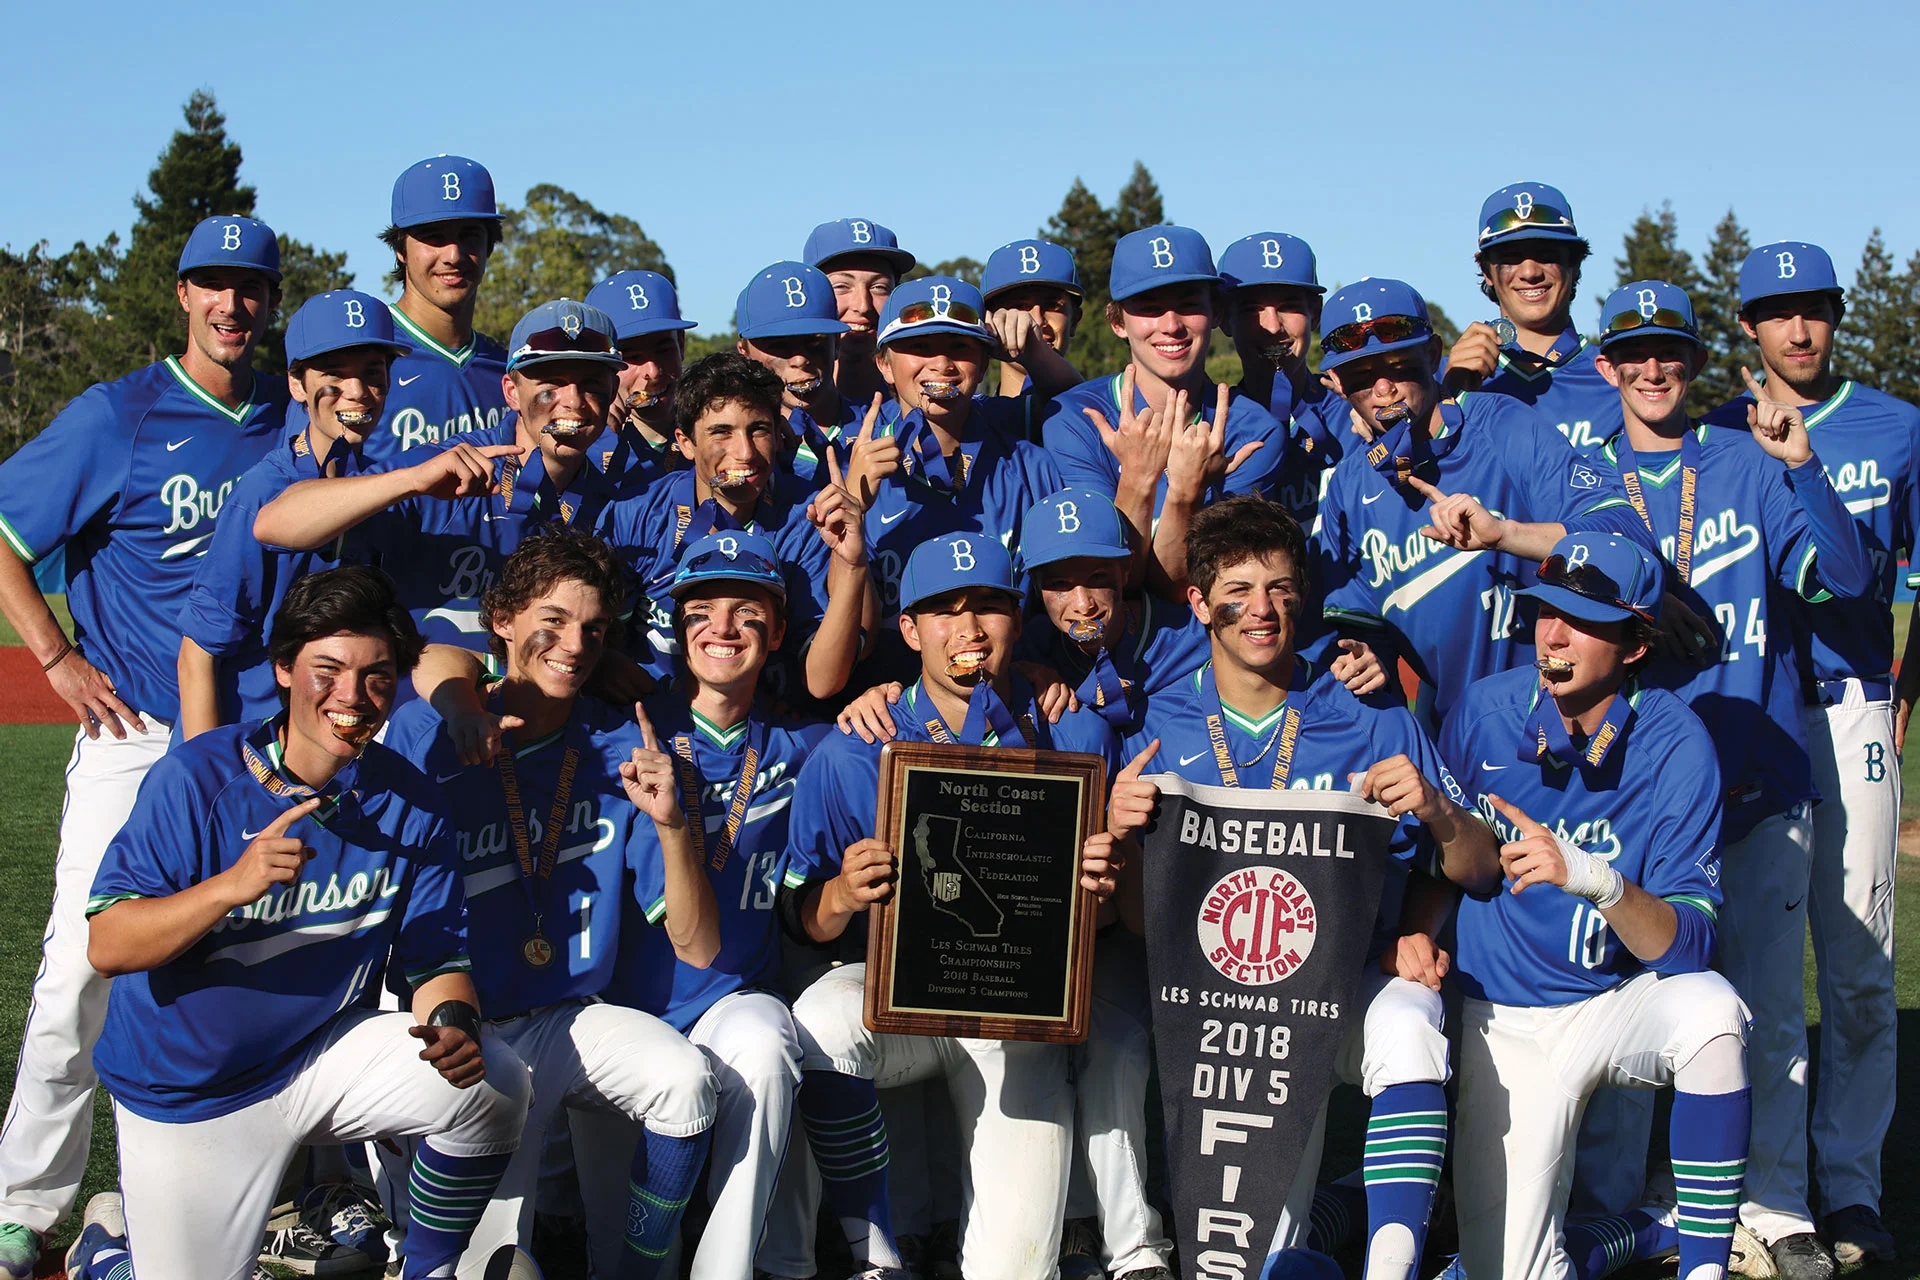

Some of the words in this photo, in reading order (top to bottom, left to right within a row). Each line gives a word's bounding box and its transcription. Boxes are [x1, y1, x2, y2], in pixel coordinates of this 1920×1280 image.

[442, 172, 461, 201] B
[221, 224, 242, 251] B
[851, 221, 873, 244] B
[1018, 246, 1041, 274] B
[1149, 236, 1174, 268] B
[1260, 240, 1284, 269] B
[1776, 251, 1797, 279] B
[626, 284, 649, 310] B
[780, 277, 808, 309] B
[930, 284, 952, 310] B
[1636, 289, 1658, 319] B
[344, 299, 367, 328] B
[1055, 501, 1081, 534] B
[949, 539, 977, 571] B
[1715, 597, 1767, 662] 24
[1276, 706, 1302, 764] CHAMPIONSHIPS
[1586, 720, 1618, 767] HAMPIONSHIPS
[1864, 741, 1887, 783] B
[939, 781, 989, 798] North
[998, 785, 1047, 801] Coast
[960, 798, 1021, 815] Section
[1180, 809, 1354, 859] BASEBALL
[739, 850, 777, 911] 13
[933, 872, 962, 903] NCS
[1202, 870, 1257, 925] NORTH
[1269, 873, 1314, 933] COAST
[1222, 889, 1295, 963] CIF
[1568, 902, 1607, 969] 10
[943, 970, 968, 981] 2018
[1210, 946, 1303, 982] SECTION
[969, 986, 977, 996] 5
[1161, 986, 1190, 1005] LES
[1199, 990, 1280, 1013] SCHWAB
[1291, 999, 1340, 1020] TIRES
[1200, 1019, 1291, 1060] 2018
[1192, 1062, 1254, 1102] DIV
[1267, 1069, 1291, 1106] 5
